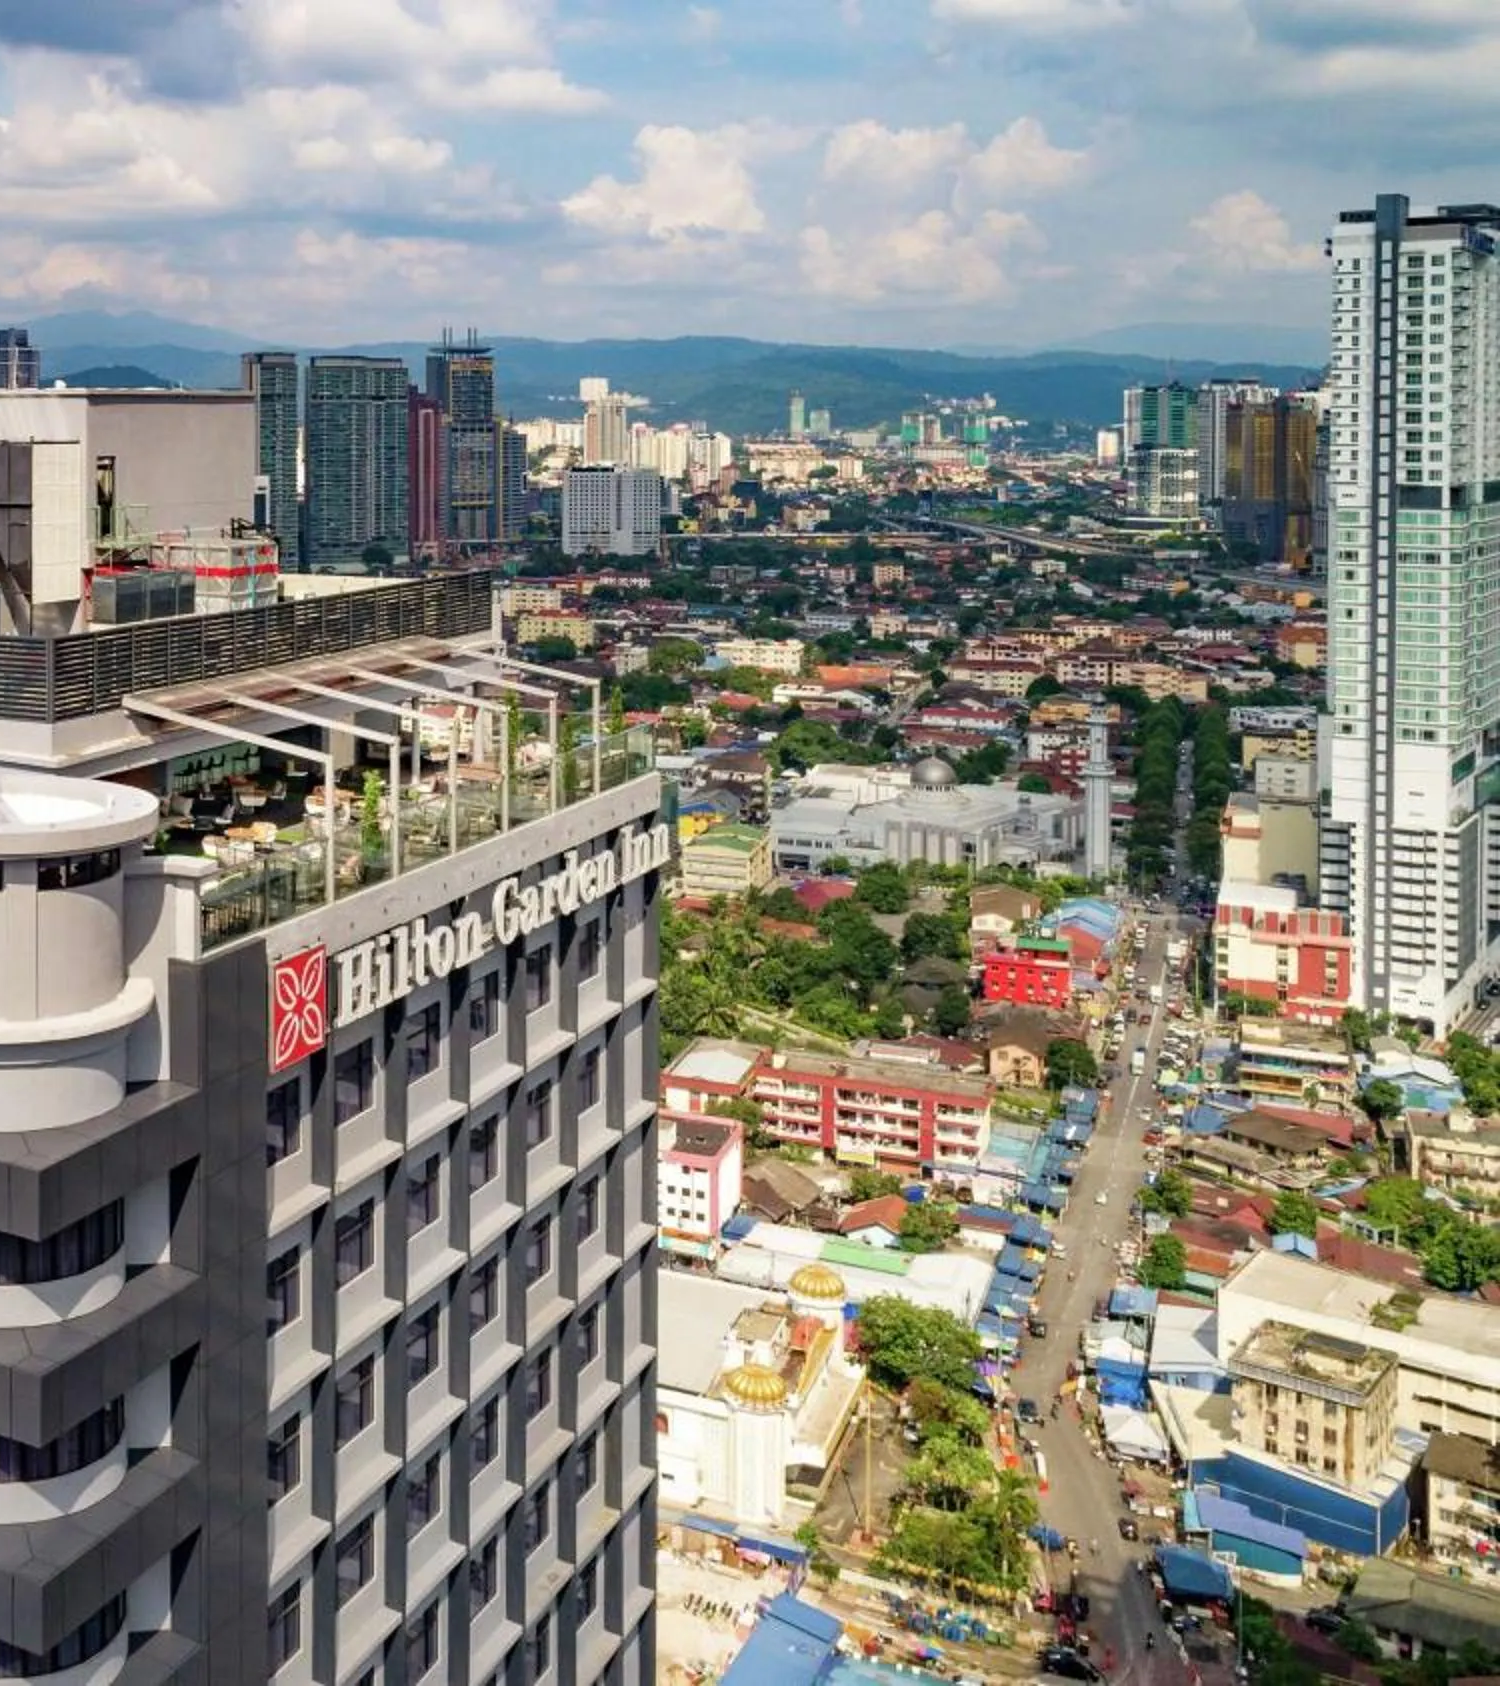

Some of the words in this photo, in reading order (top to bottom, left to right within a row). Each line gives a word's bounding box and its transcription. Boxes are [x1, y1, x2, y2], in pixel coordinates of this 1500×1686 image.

[336, 907, 485, 1027] Hilton
[492, 849, 617, 945] Garden
[619, 822, 670, 885] Inn
